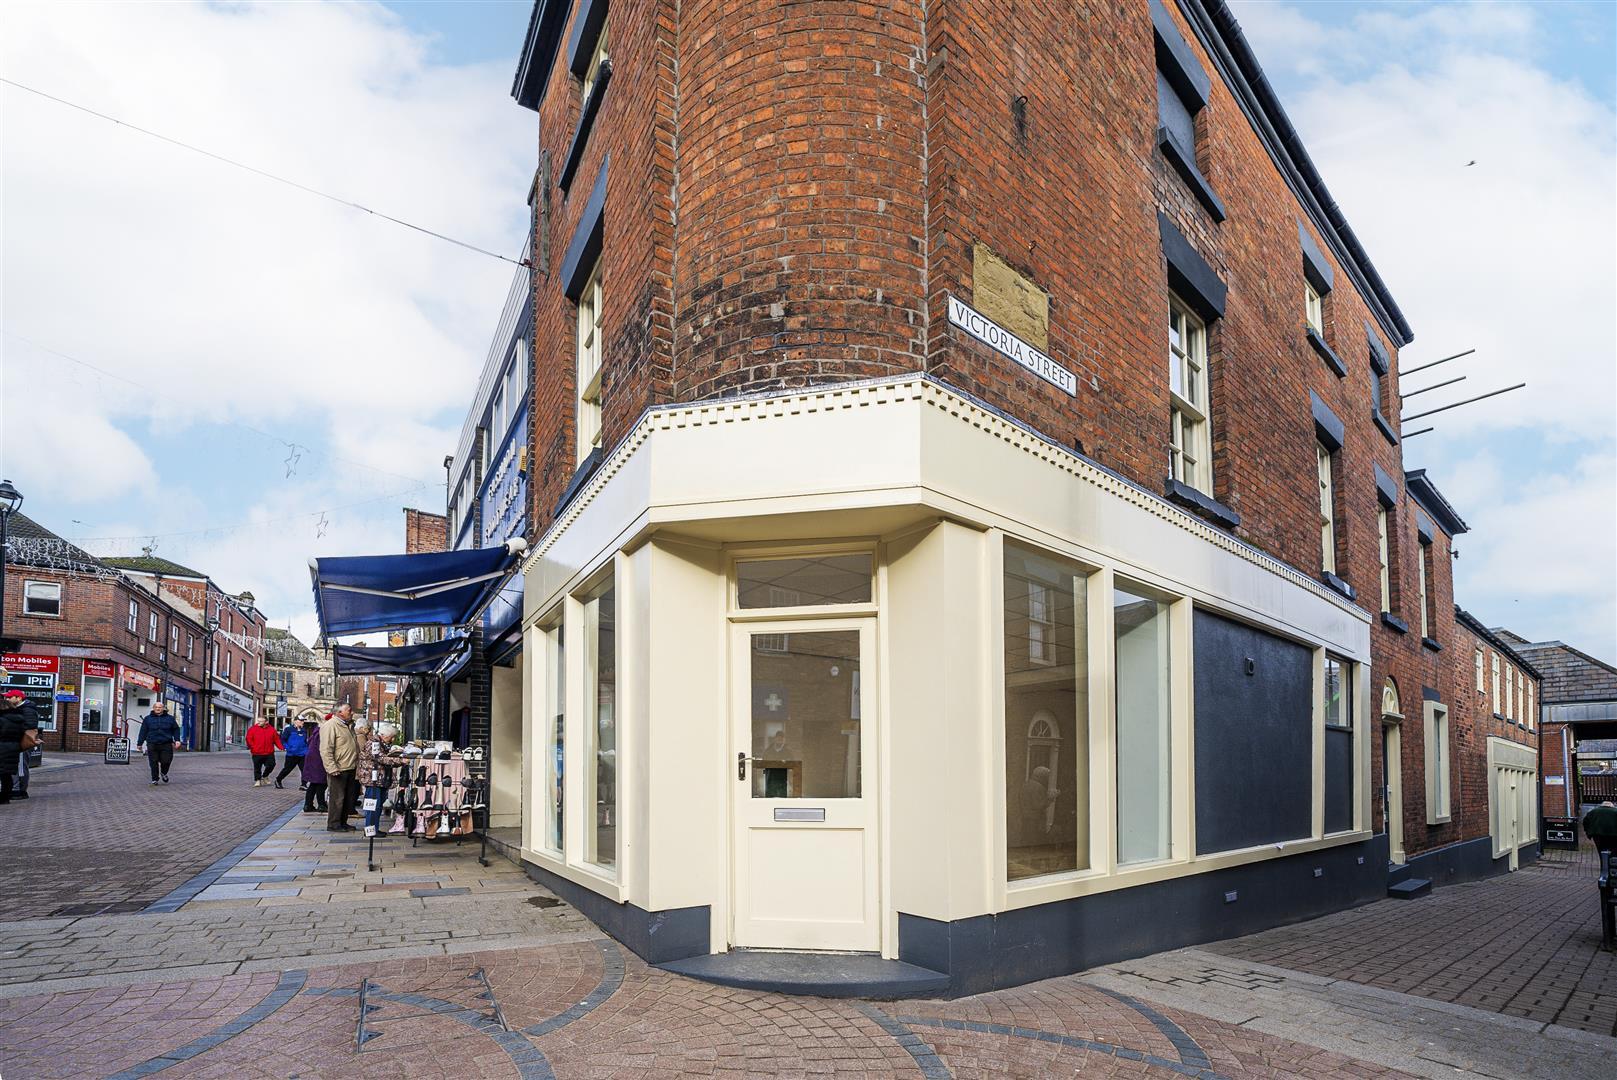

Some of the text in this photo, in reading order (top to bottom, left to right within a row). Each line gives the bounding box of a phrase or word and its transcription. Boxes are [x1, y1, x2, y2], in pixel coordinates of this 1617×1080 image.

[955, 303, 1072, 389] VICTORIA STREET
[17, 656, 52, 664] Mobiles
